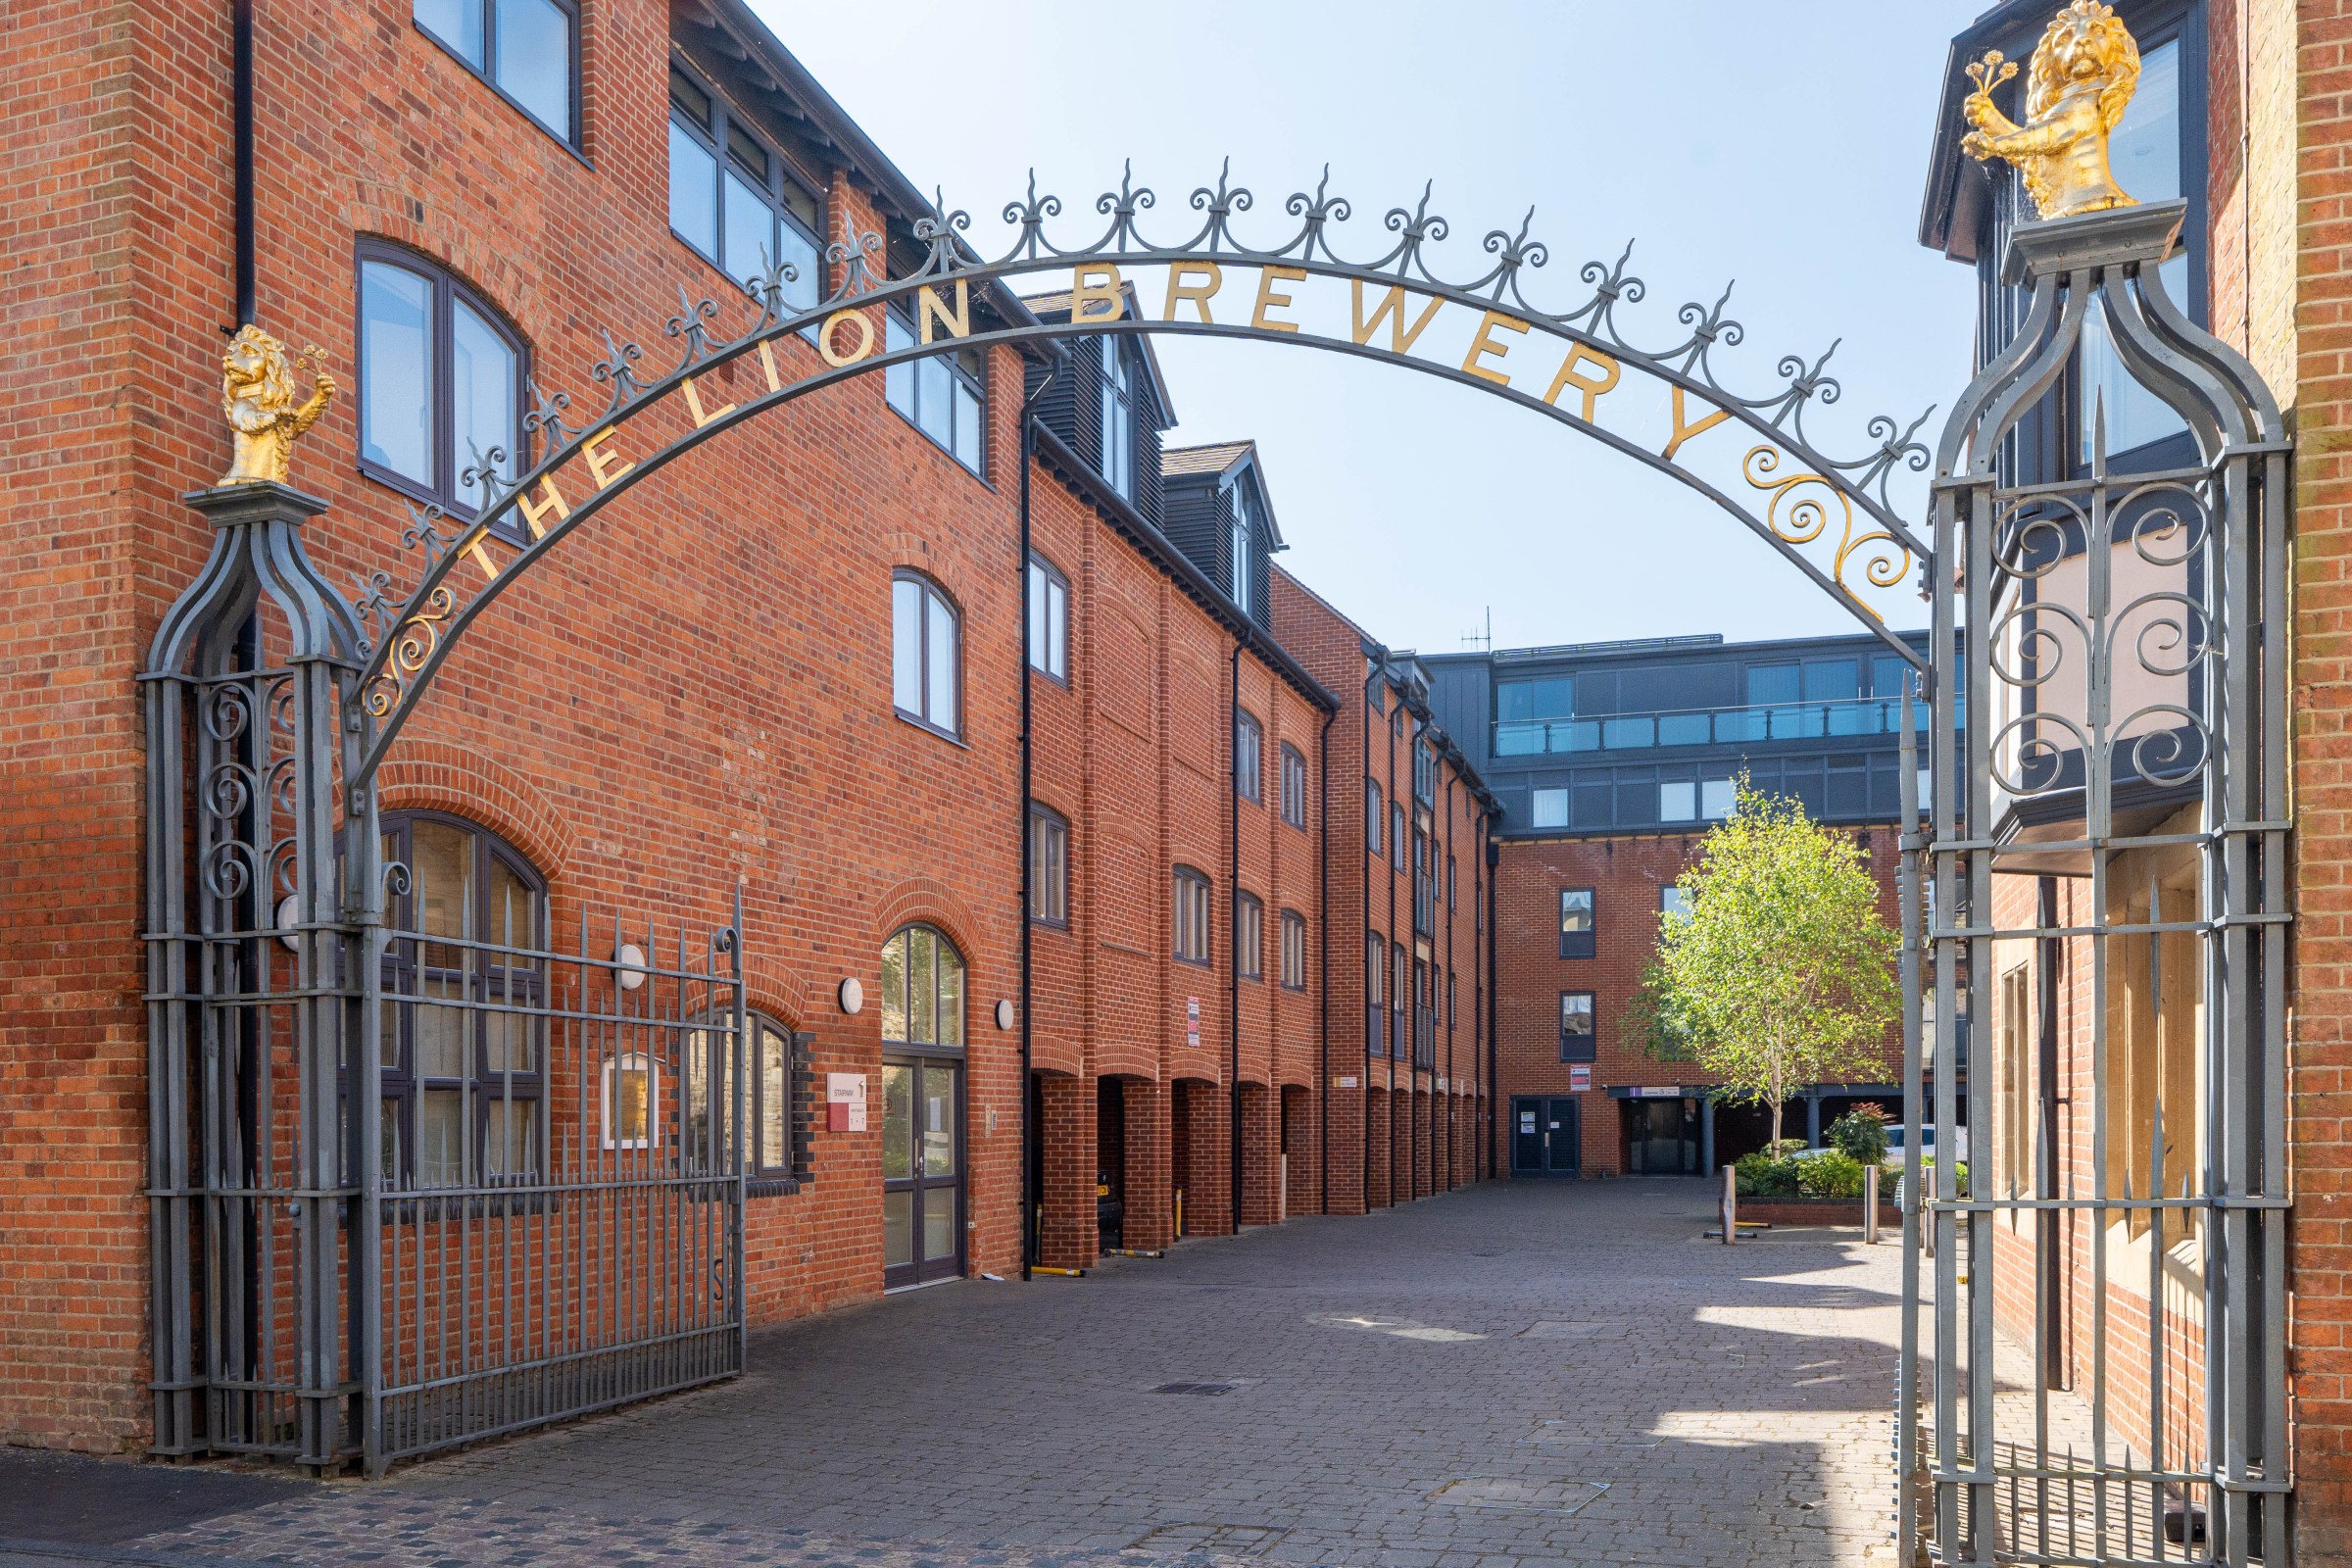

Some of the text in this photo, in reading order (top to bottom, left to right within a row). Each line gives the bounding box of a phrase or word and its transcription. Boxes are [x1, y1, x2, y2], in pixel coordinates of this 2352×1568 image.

[457, 261, 1734, 581] THE LION BREWERY
[858, 1080, 864, 1098] 1
